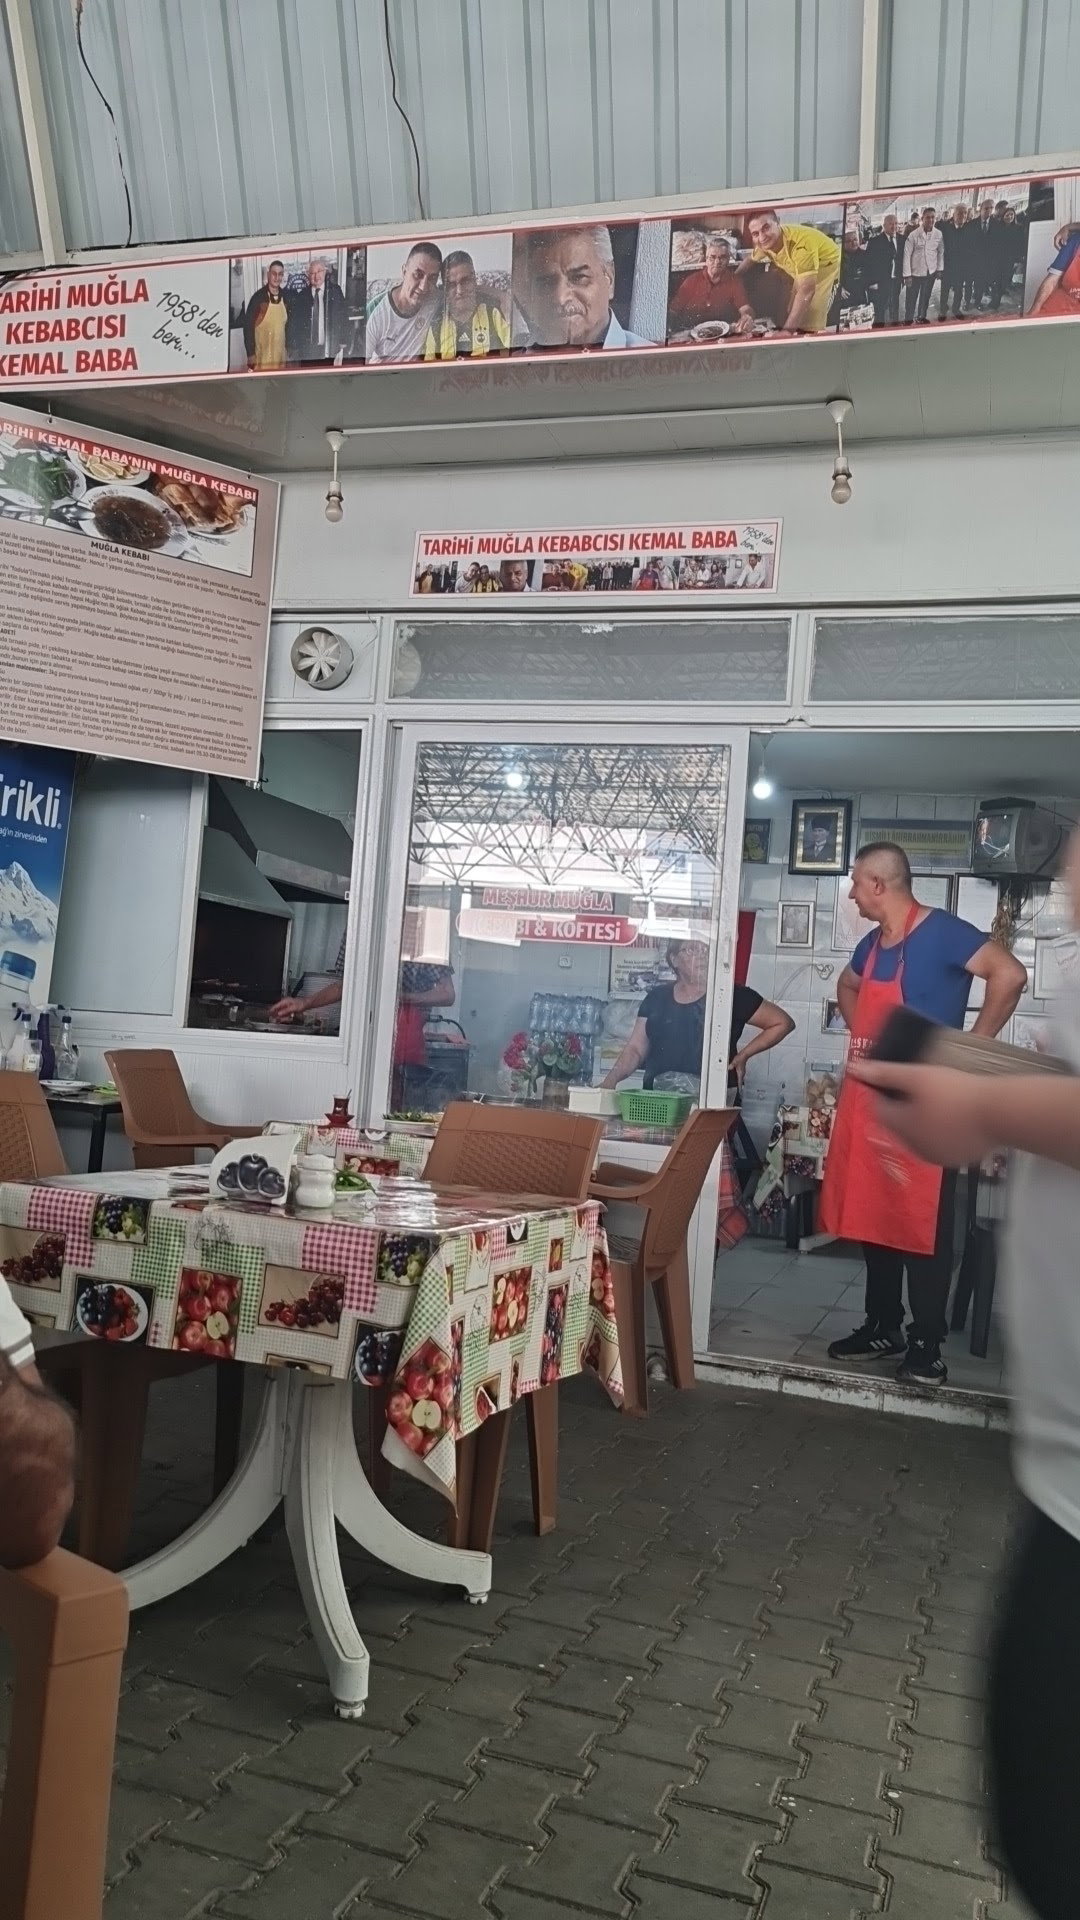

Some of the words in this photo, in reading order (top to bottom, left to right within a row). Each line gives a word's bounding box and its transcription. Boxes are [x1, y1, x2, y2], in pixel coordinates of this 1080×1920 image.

[0, 279, 62, 314] ARİHİ
[67, 273, 149, 309] MUĞLA
[6, 314, 126, 345] KEBABCISI
[156, 291, 223, 339] 1958'den
[75, 347, 138, 373] BABA
[38, 431, 89, 454] KEMAL
[92, 446, 157, 473] BABA'NIN
[160, 464, 208, 488] MUĞLA
[210, 479, 257, 502] KEBABI
[90, 540, 120, 554] MUĞLA
[121, 547, 150, 561] KEBABI
[477, 532, 534, 554] MUĞLA
[538, 533, 625, 553] KEBABCISI
[629, 531, 687, 551] KEMAL
[691, 530, 738, 549] BABA
[0, 773, 61, 829] rikli
